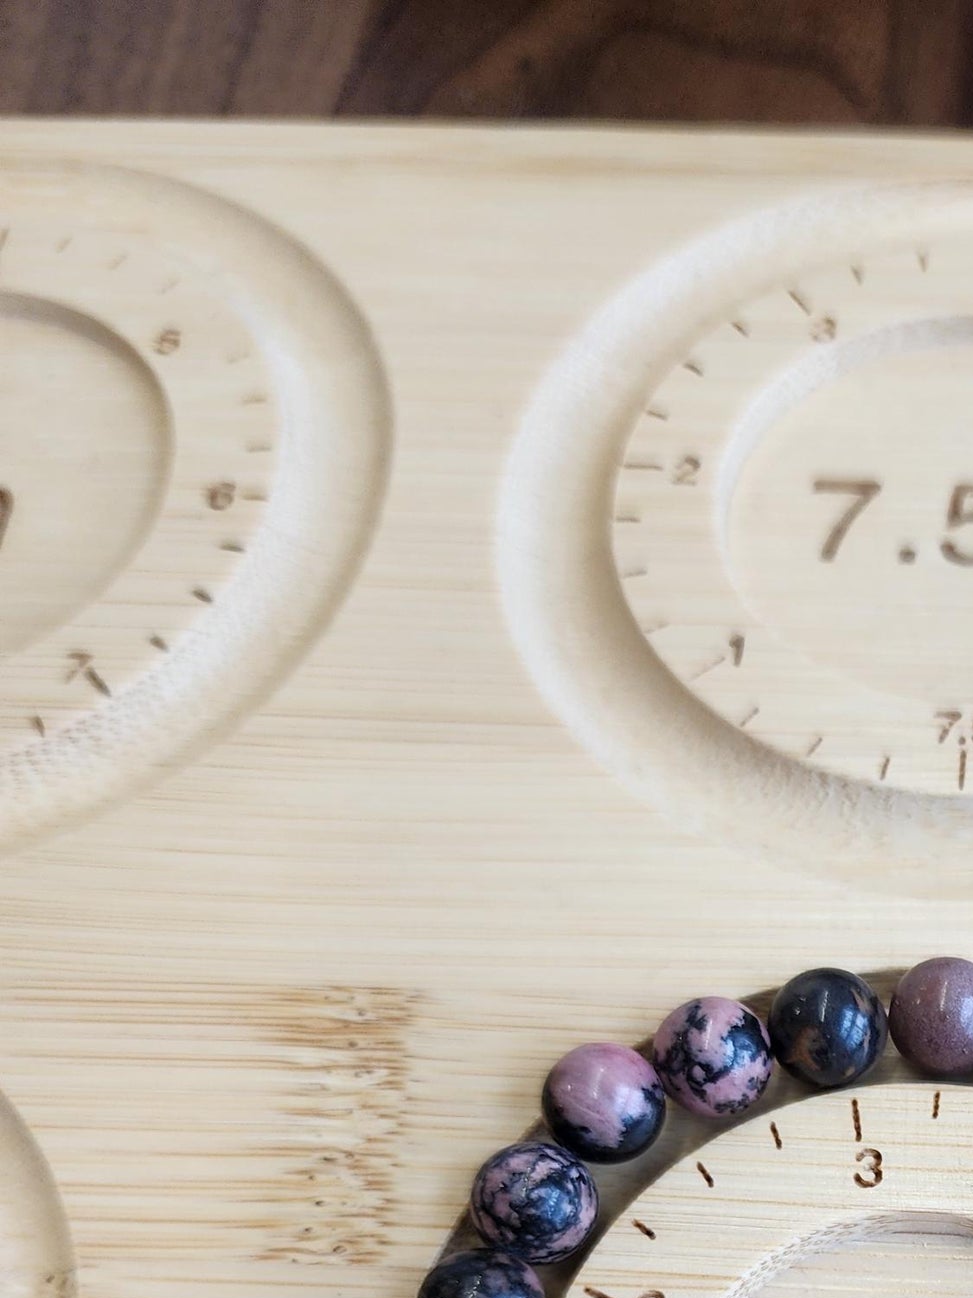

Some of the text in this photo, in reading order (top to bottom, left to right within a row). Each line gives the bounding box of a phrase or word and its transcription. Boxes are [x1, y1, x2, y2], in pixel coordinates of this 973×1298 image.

[811, 316, 838, 342] 3
[671, 457, 702, 485] 2
[729, 634, 746, 667] 1
[853, 1147, 885, 1189] 3
